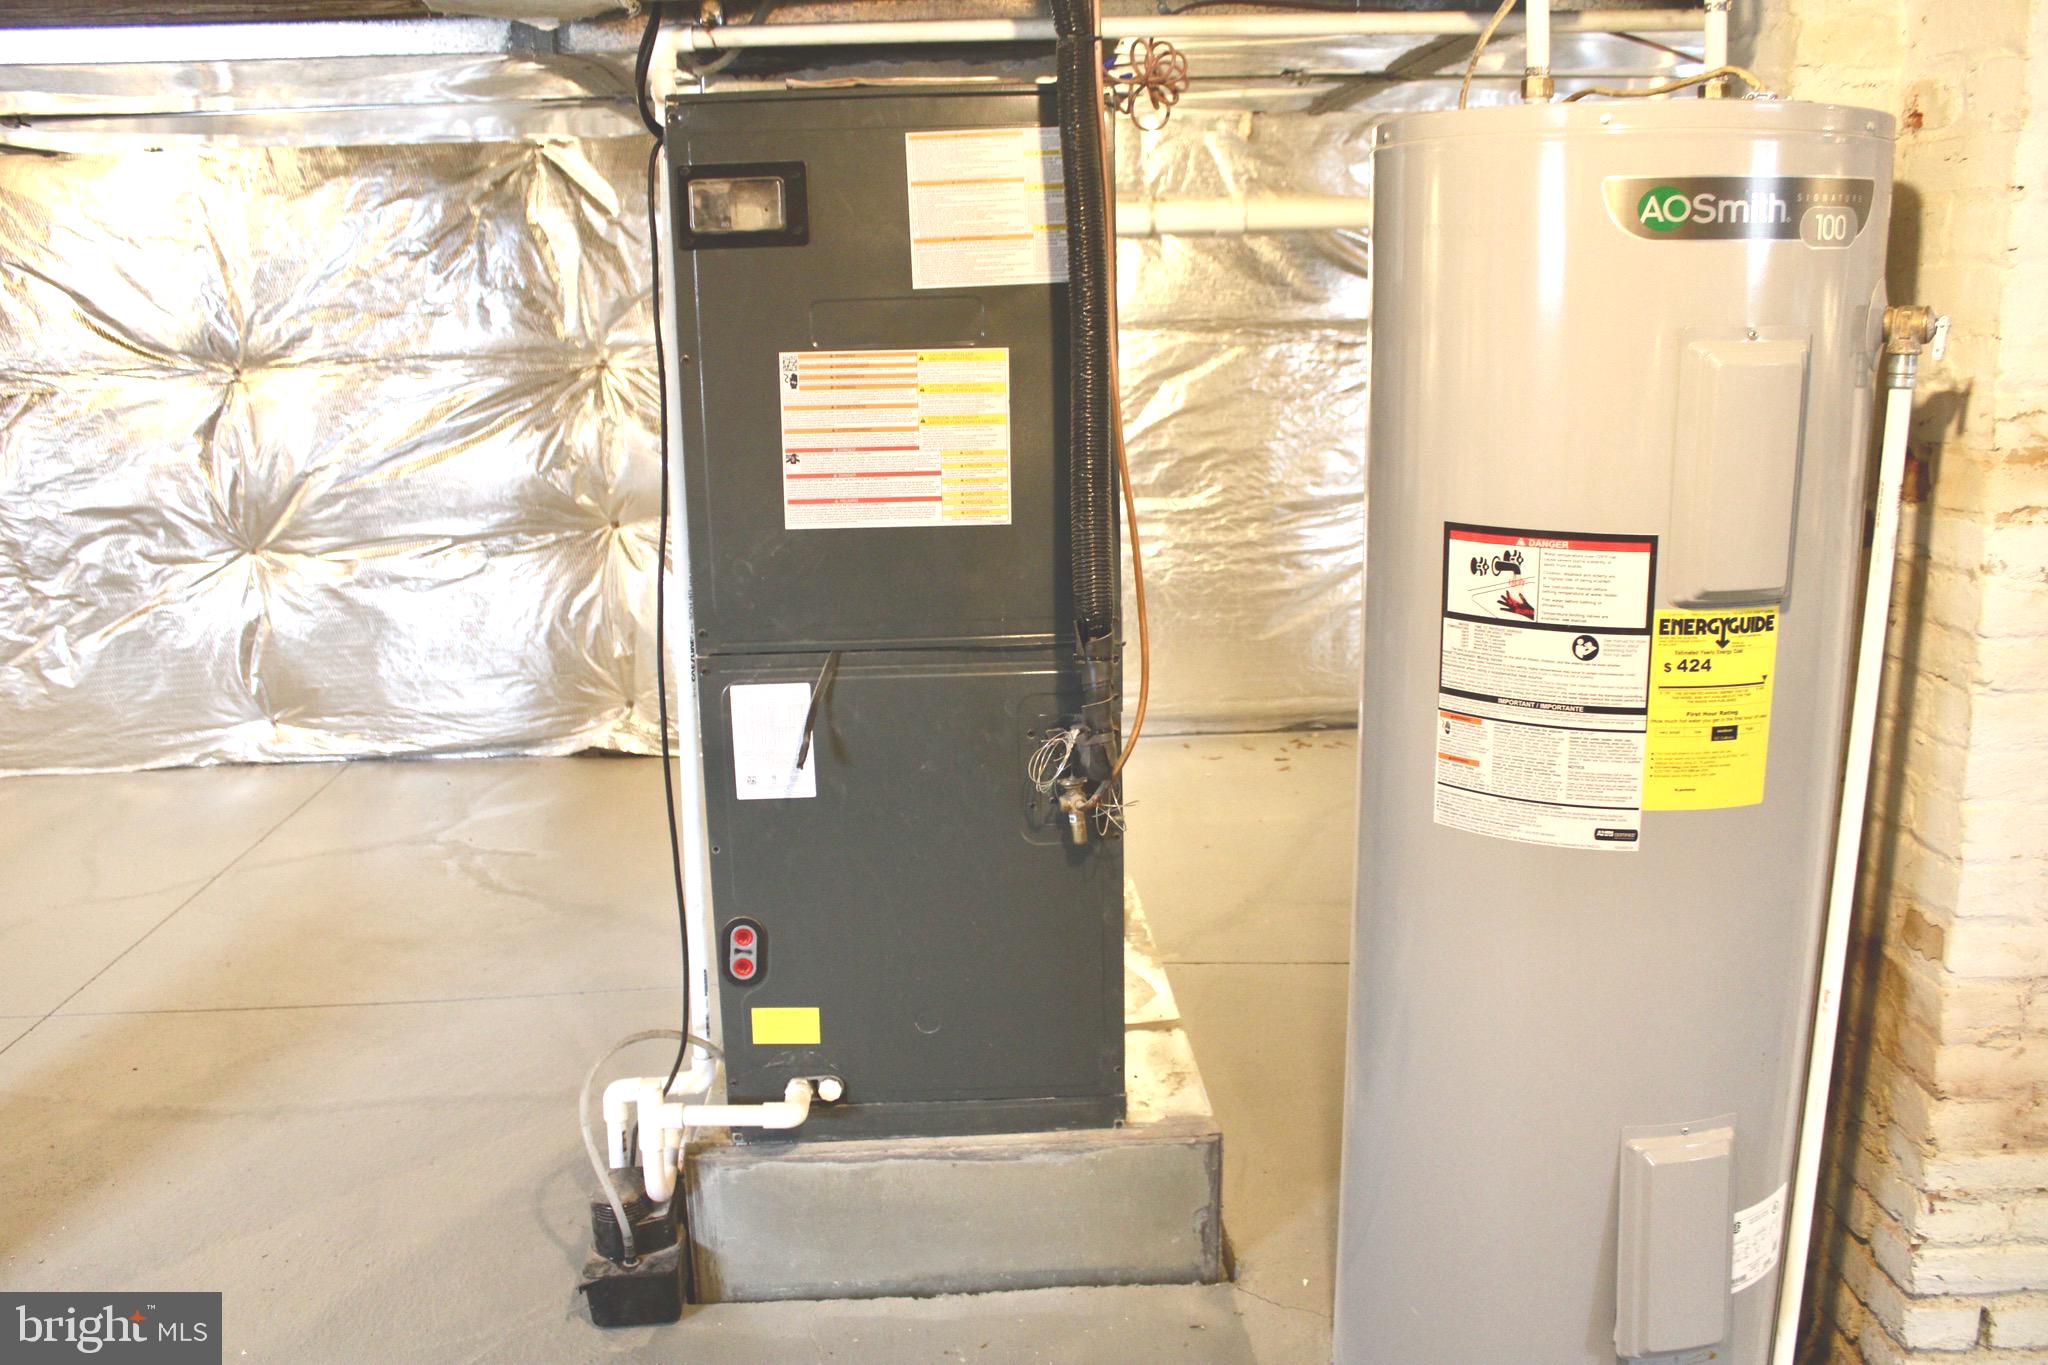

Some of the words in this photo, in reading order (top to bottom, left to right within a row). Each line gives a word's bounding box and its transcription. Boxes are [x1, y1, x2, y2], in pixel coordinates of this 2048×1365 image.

[1815, 214, 1846, 240] 100
[1528, 539, 1569, 549] DANGER
[1659, 615, 1775, 637] ENERGYGUIDE
[1676, 658, 1712, 673] 424
[1498, 698, 1535, 708] IMPORTANT
[1540, 702, 1584, 713] IMPORTANTE
